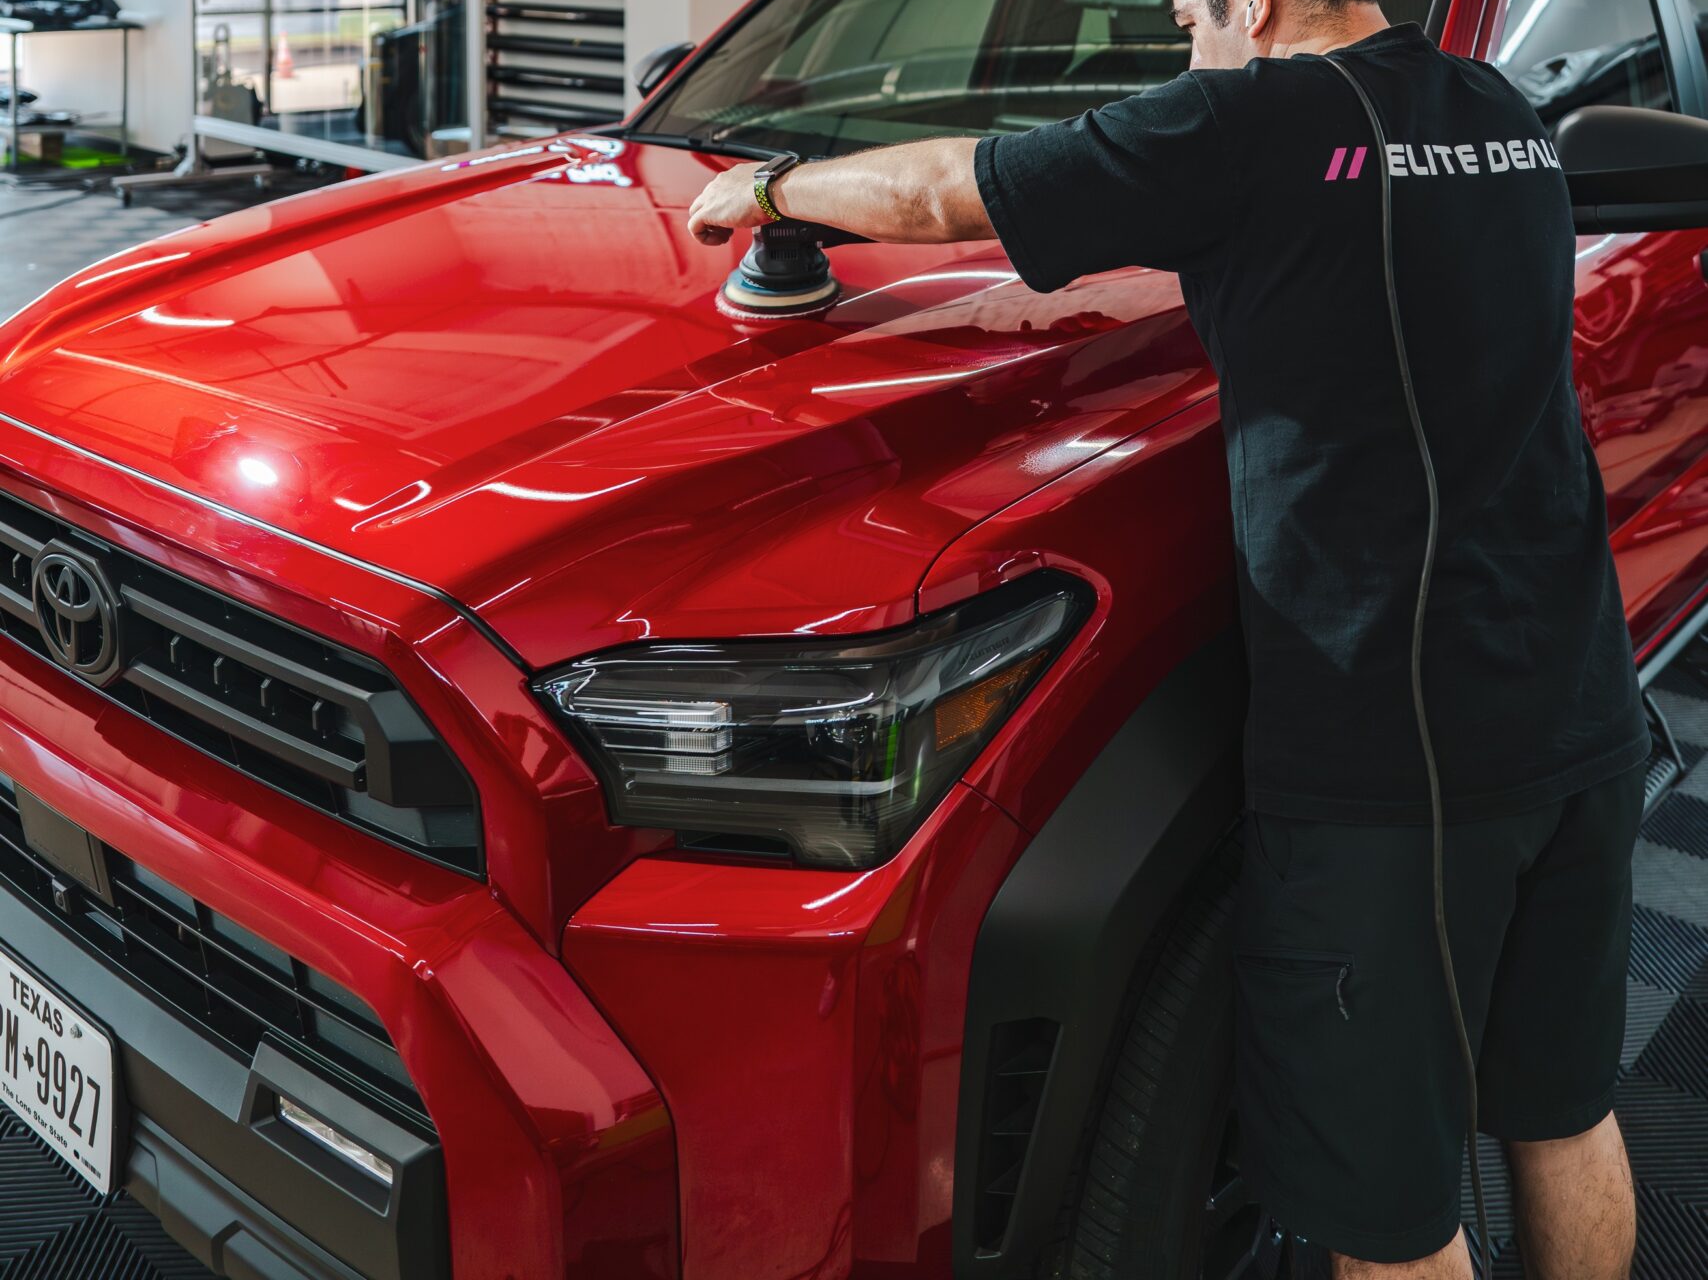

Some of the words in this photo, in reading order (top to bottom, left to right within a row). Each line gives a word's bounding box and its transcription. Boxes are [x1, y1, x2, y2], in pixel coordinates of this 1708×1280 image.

[1385, 143, 1480, 177] ELITE
[1485, 138, 1562, 173] DEAL
[10, 971, 64, 1038] TEXAS
[0, 1002, 19, 1081] M
[37, 1036, 101, 1149] 9927
[2, 1081, 14, 1099] The
[15, 1093, 32, 1116] Lone
[33, 1109, 48, 1129] Star
[49, 1124, 68, 1149] State
